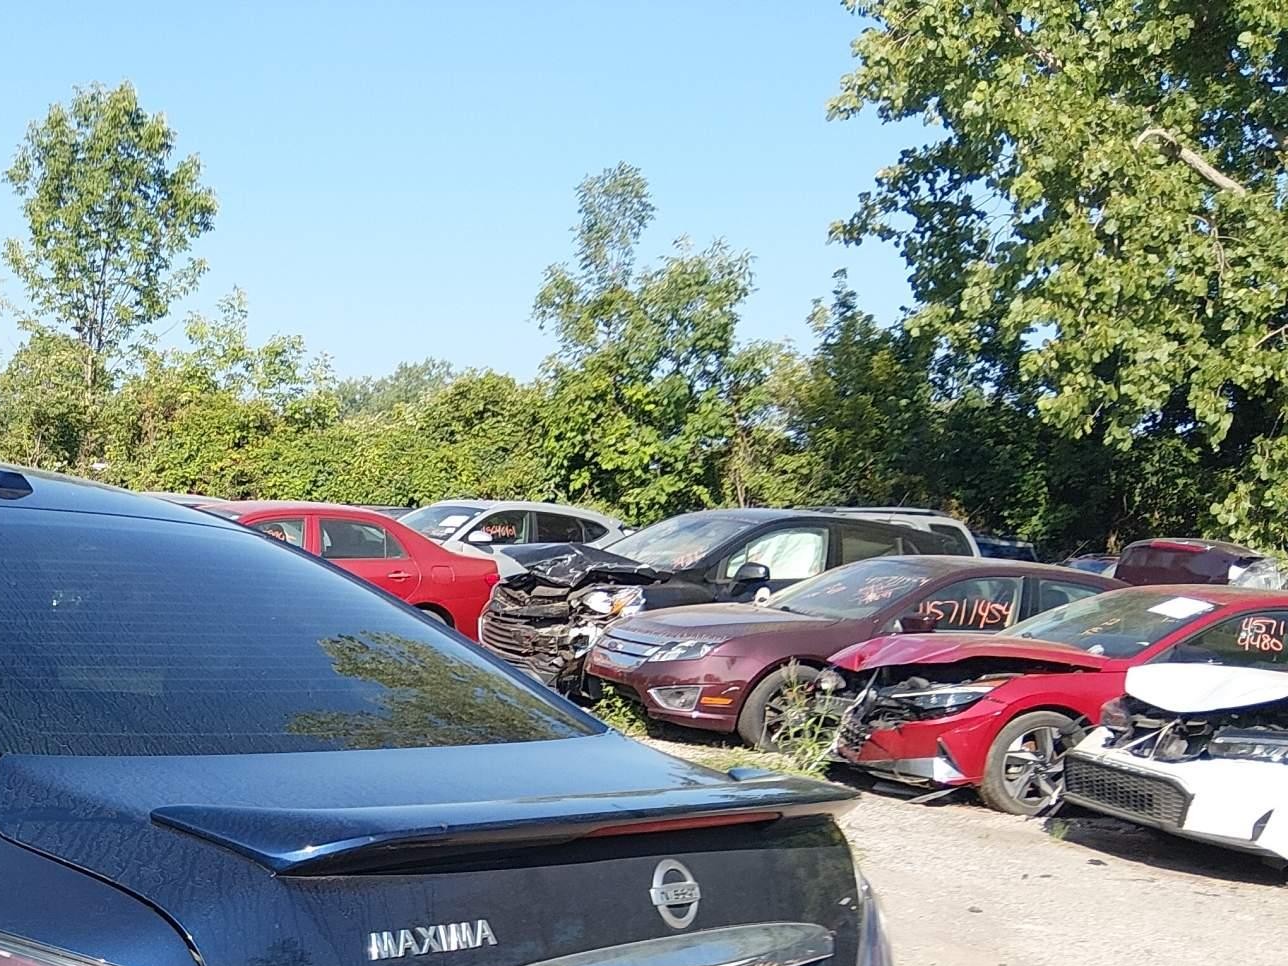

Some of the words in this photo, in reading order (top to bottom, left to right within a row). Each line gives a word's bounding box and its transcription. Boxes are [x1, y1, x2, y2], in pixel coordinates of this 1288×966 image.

[1241, 617, 1285, 636] 4571
[1237, 632, 1284, 651] 4480
[368, 919, 498, 960] MAXIMA
